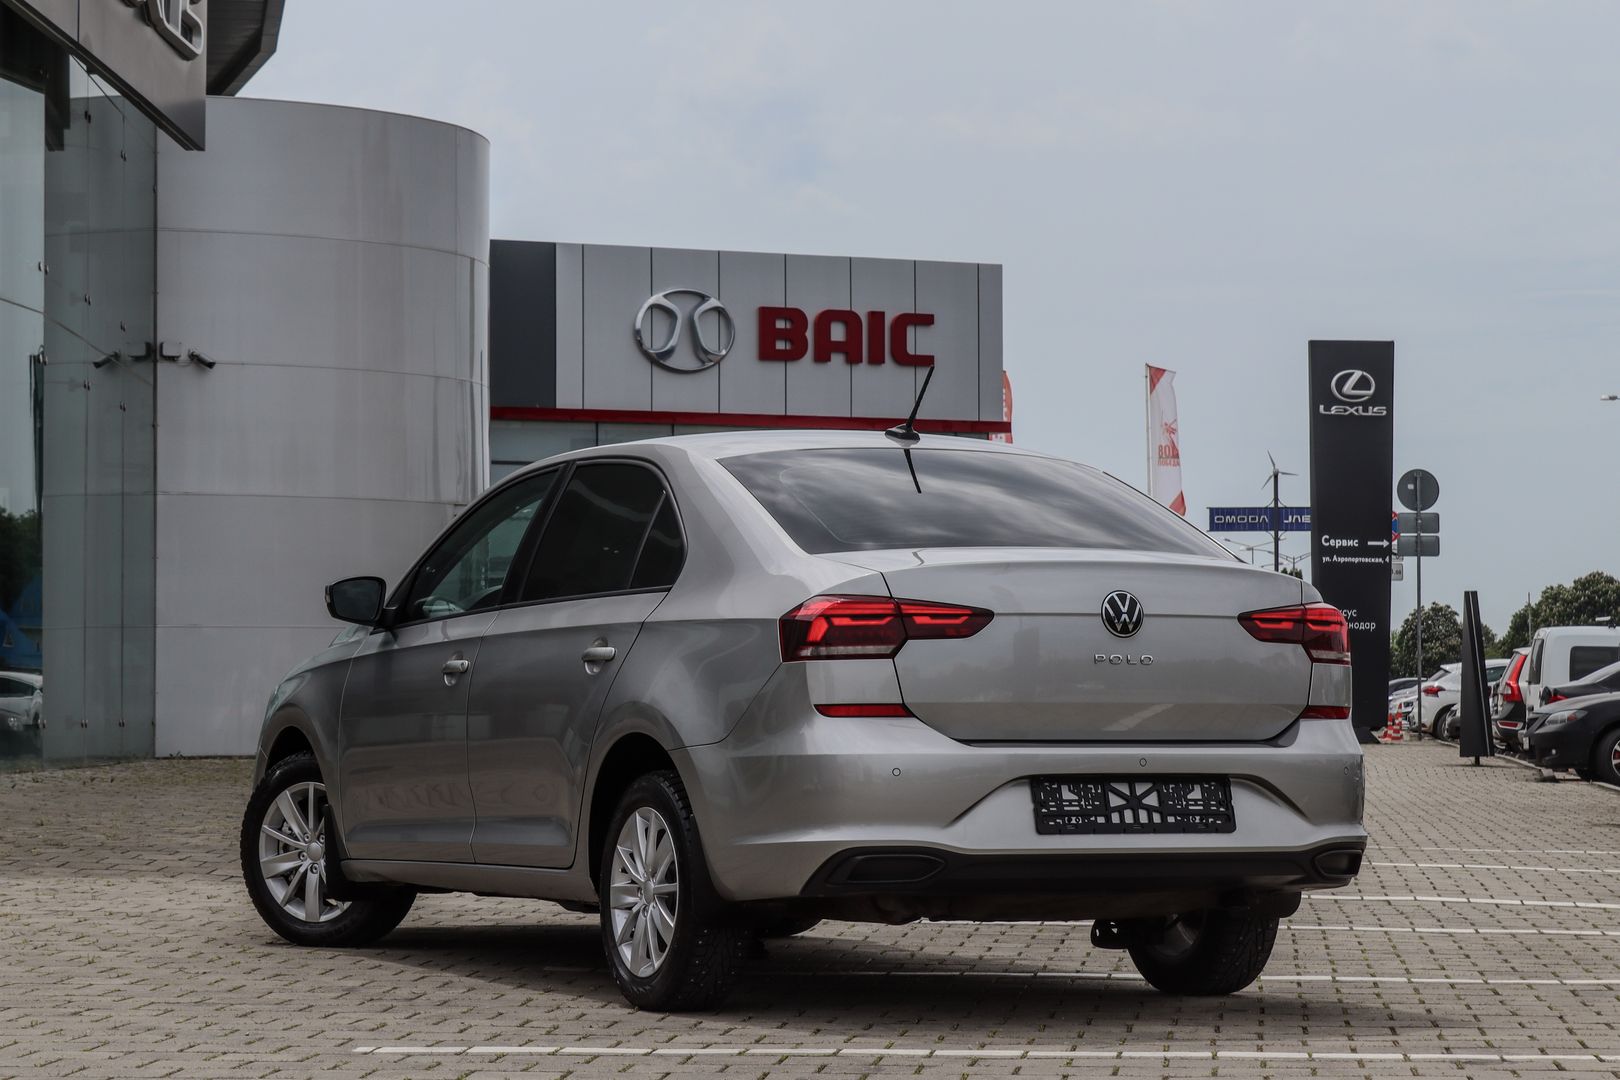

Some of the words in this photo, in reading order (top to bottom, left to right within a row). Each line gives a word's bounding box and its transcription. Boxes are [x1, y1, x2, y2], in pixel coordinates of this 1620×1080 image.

[757, 306, 935, 367] BAIC
[1319, 404, 1387, 416] LEXUS
[1214, 515, 1269, 524] OMODA
[1283, 515, 1312, 524] JAE
[1321, 534, 1359, 549] Сервис
[1322, 556, 1331, 564] ул.
[1332, 554, 1384, 564] Аэропортовская,
[1346, 621, 1376, 632] нодар
[1093, 653, 1154, 666] POLO
